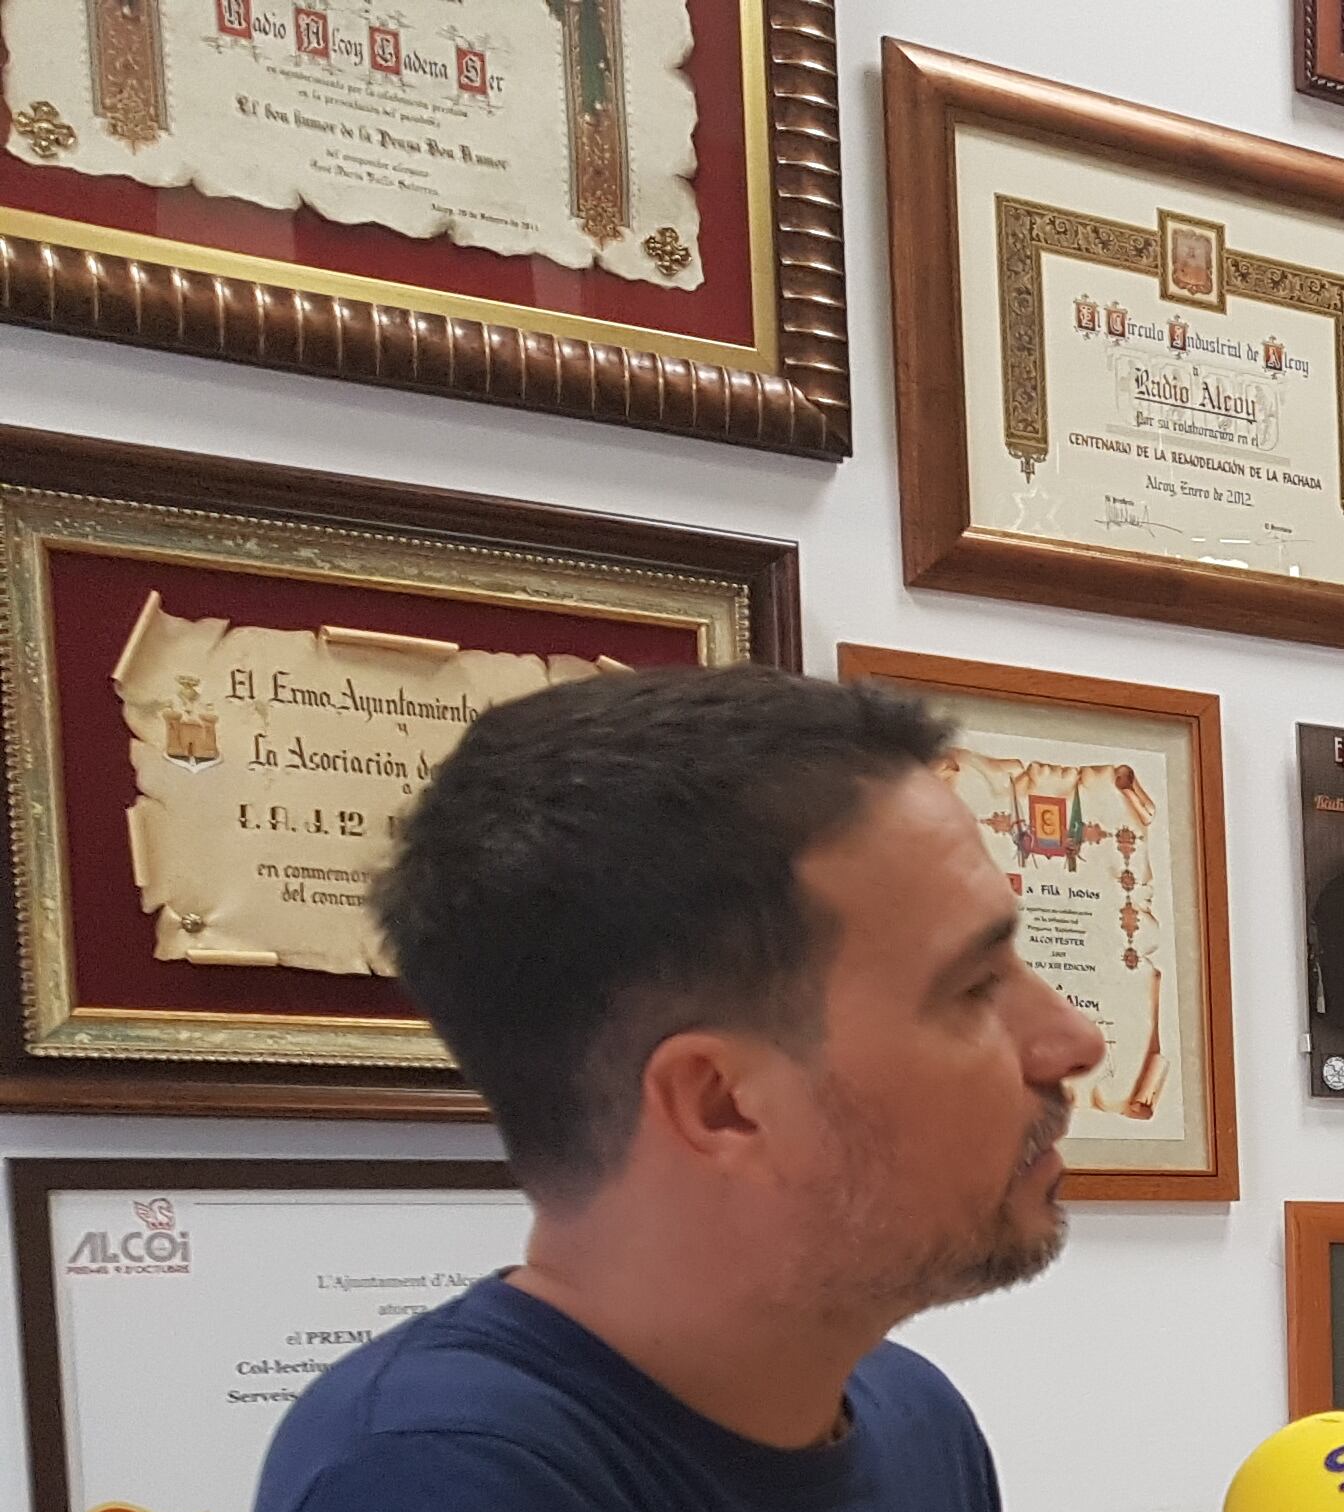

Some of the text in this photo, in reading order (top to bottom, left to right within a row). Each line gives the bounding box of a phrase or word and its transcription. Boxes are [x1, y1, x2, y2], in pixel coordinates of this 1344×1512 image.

[1246, 345, 1260, 362] de
[1264, 344, 1310, 378] Alcoy
[1135, 367, 1257, 422] Radio Alcoy
[1157, 419, 1170, 431] su
[1237, 434, 1249, 445] en
[1251, 434, 1259, 448] el
[1069, 432, 1322, 491] CENTENARIO DE LA REMODELACIÓN DE LA FACHADA
[1213, 488, 1224, 502] de
[225, 667, 480, 725] El Ayuntamiento
[247, 732, 279, 772] La
[284, 736, 409, 780] Asociación
[338, 810, 367, 837] 12
[285, 1331, 301, 1346] el
[226, 1387, 299, 1404] Serveis
